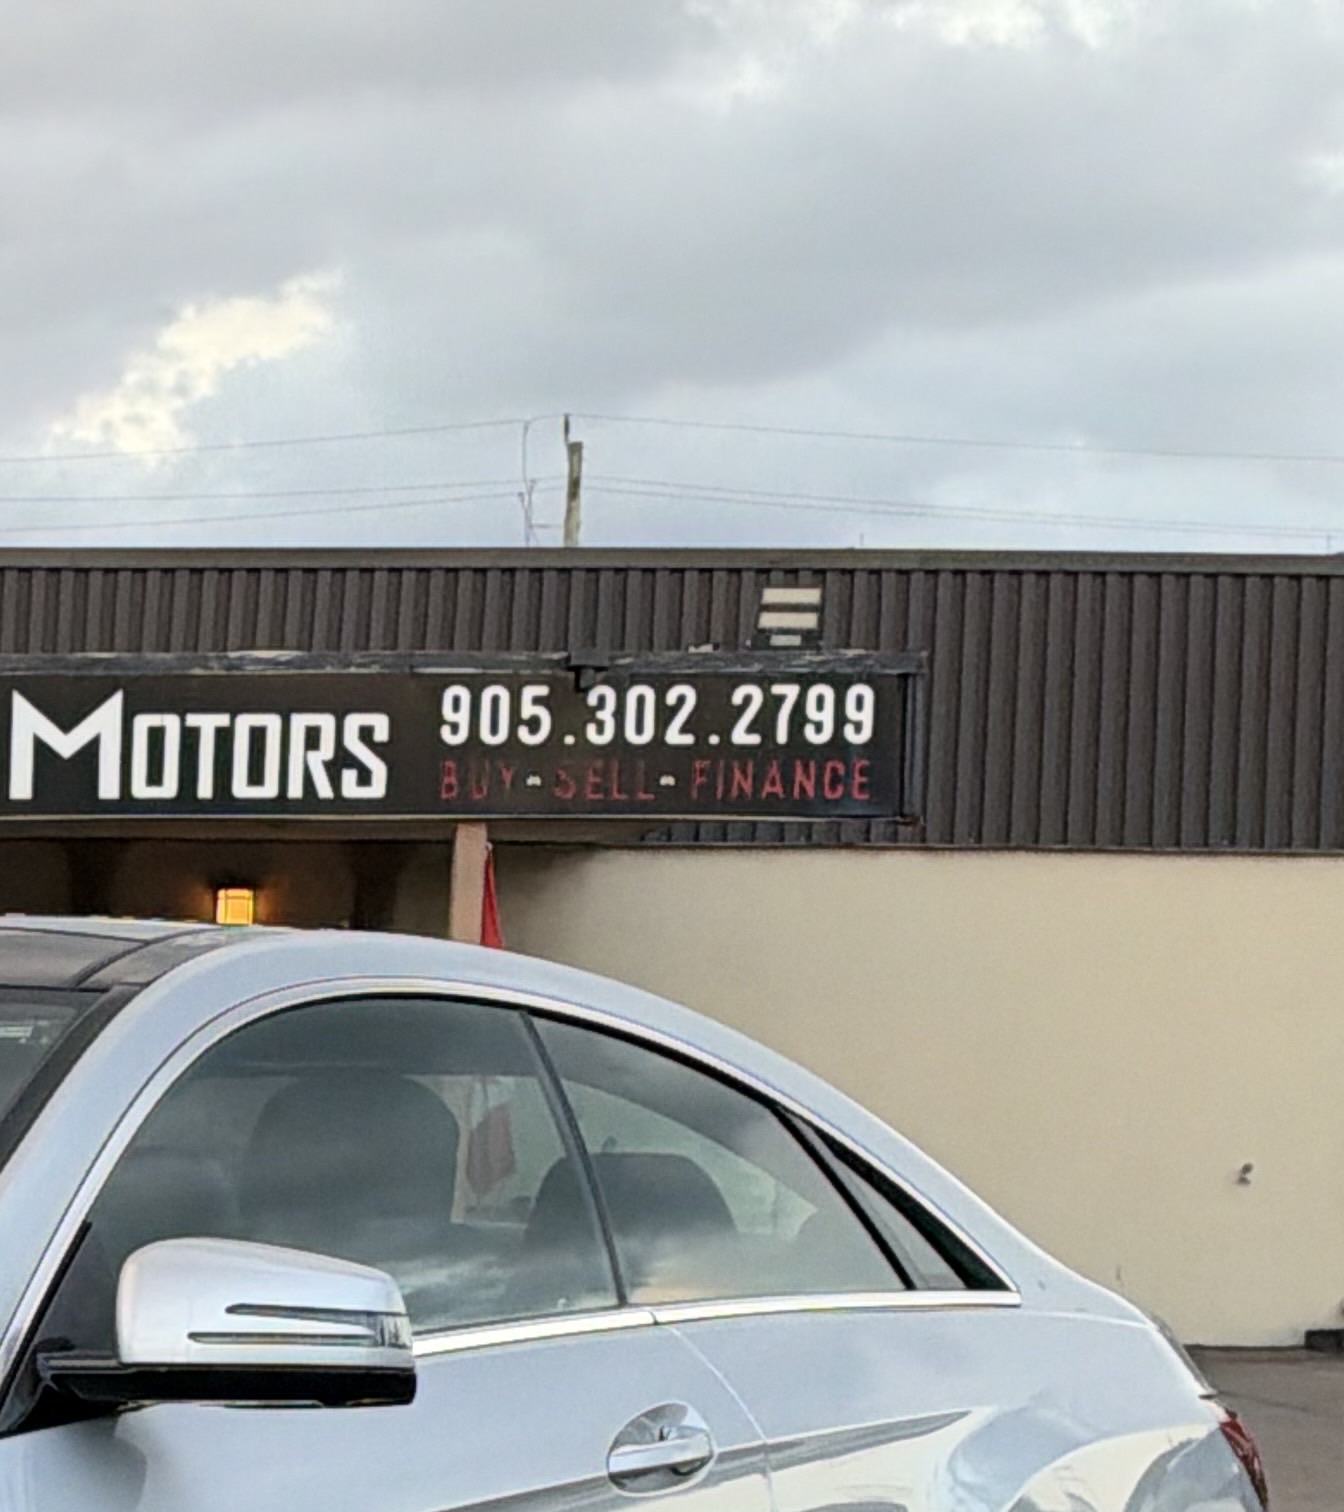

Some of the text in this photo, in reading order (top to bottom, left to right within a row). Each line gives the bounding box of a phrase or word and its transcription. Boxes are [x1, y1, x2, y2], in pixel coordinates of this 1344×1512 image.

[8, 687, 391, 801] MOTORS
[439, 683, 876, 746] 905.302.2799
[439, 757, 872, 800] BUY SELL FINANCE
